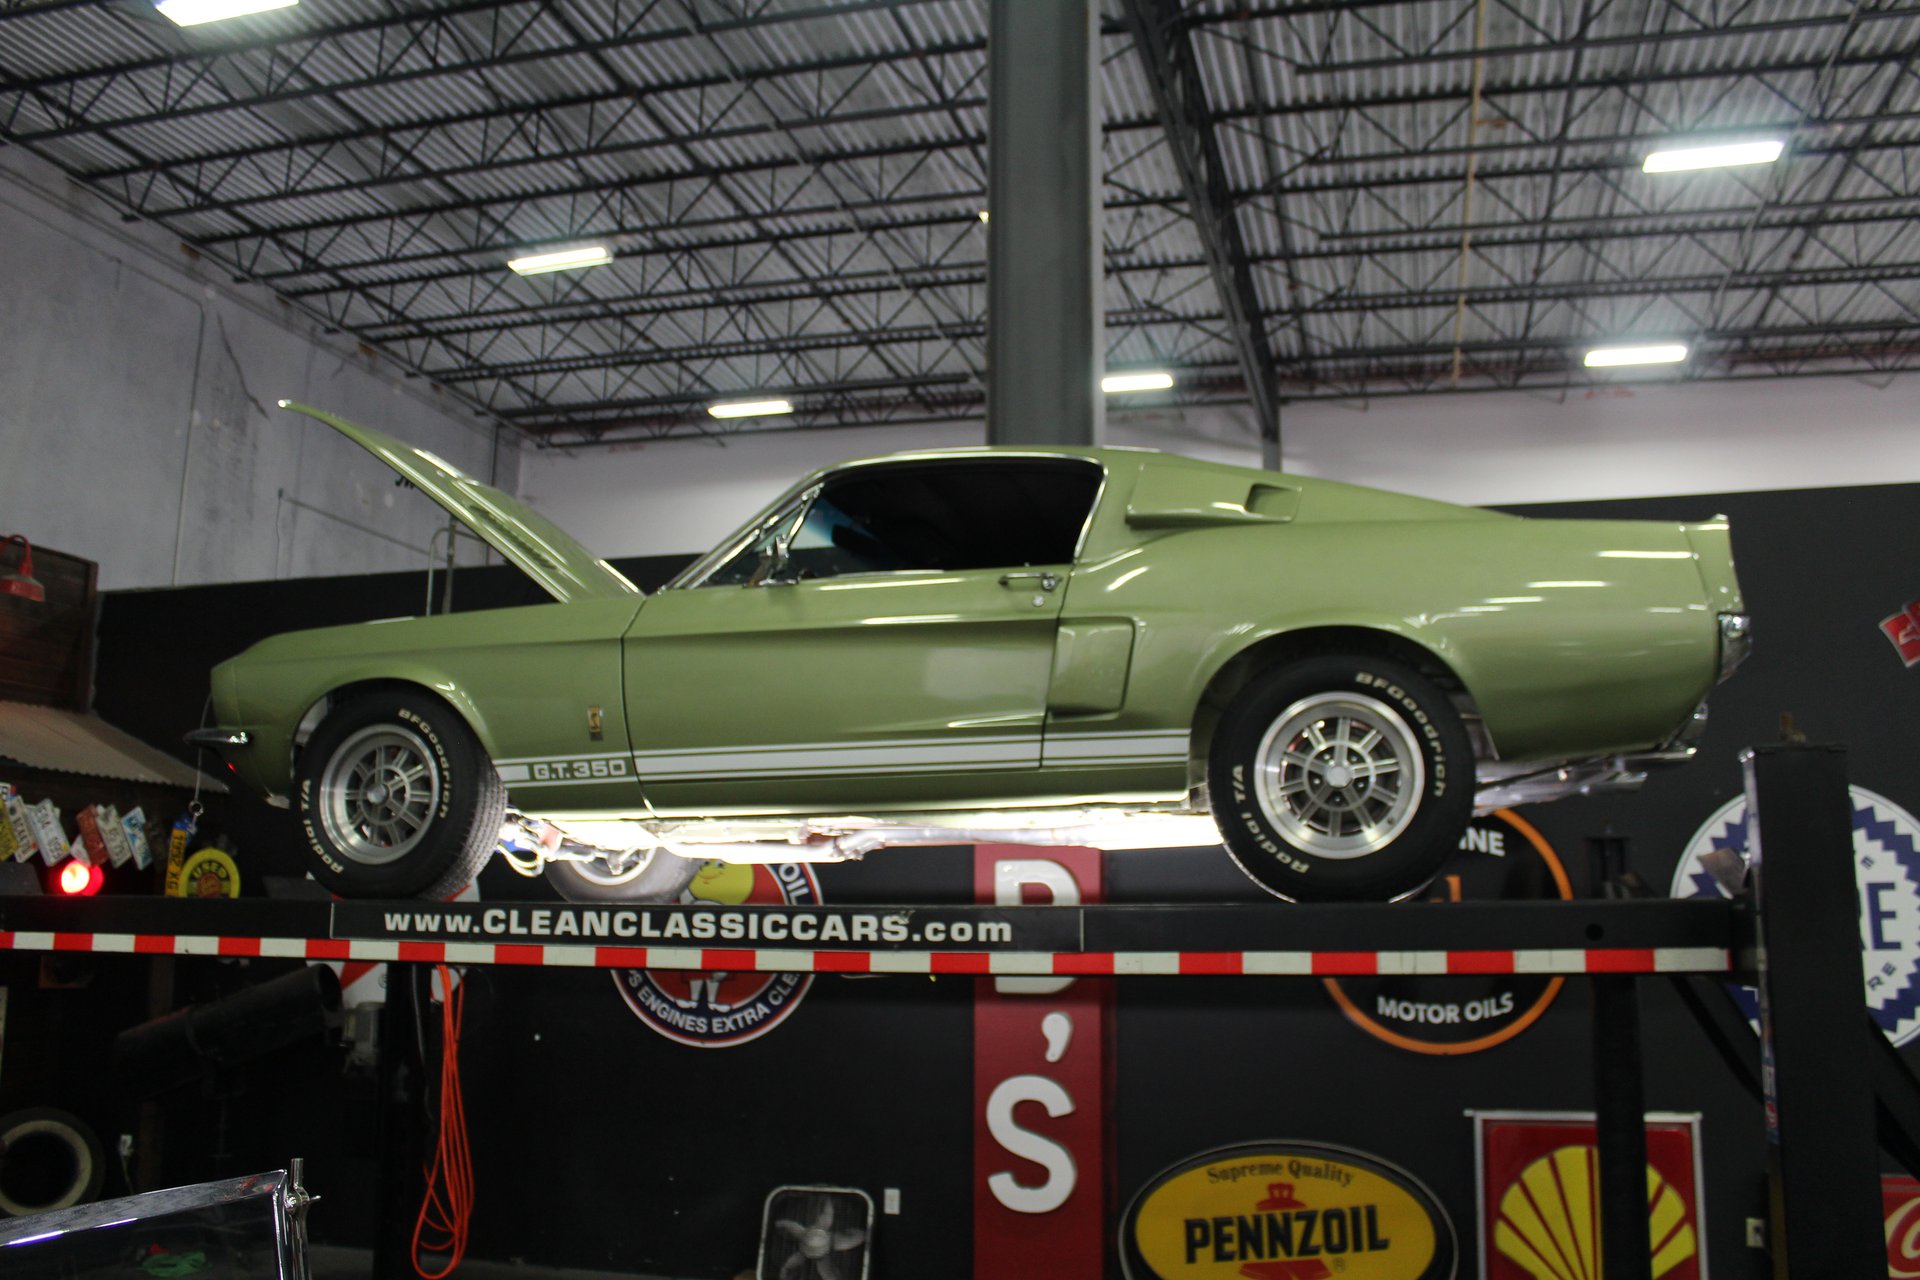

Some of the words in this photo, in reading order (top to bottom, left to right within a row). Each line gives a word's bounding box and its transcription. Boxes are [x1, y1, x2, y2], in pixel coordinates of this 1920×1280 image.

[300, 778, 312, 812] T/A
[1231, 764, 1245, 804] T/A
[384, 910, 1013, 943] www.CLEANCLASSICCARS.com
[637, 985, 708, 1034] ENGINES
[712, 1002, 771, 1034] EXTRA
[768, 972, 800, 1006] CLE
[1376, 996, 1461, 1025] MOTOR
[1464, 992, 1514, 1022] OILS
[1207, 1161, 1284, 1184] Supreme
[1288, 1159, 1354, 1187] Quality
[1184, 1204, 1391, 1265] PENNZOIL
